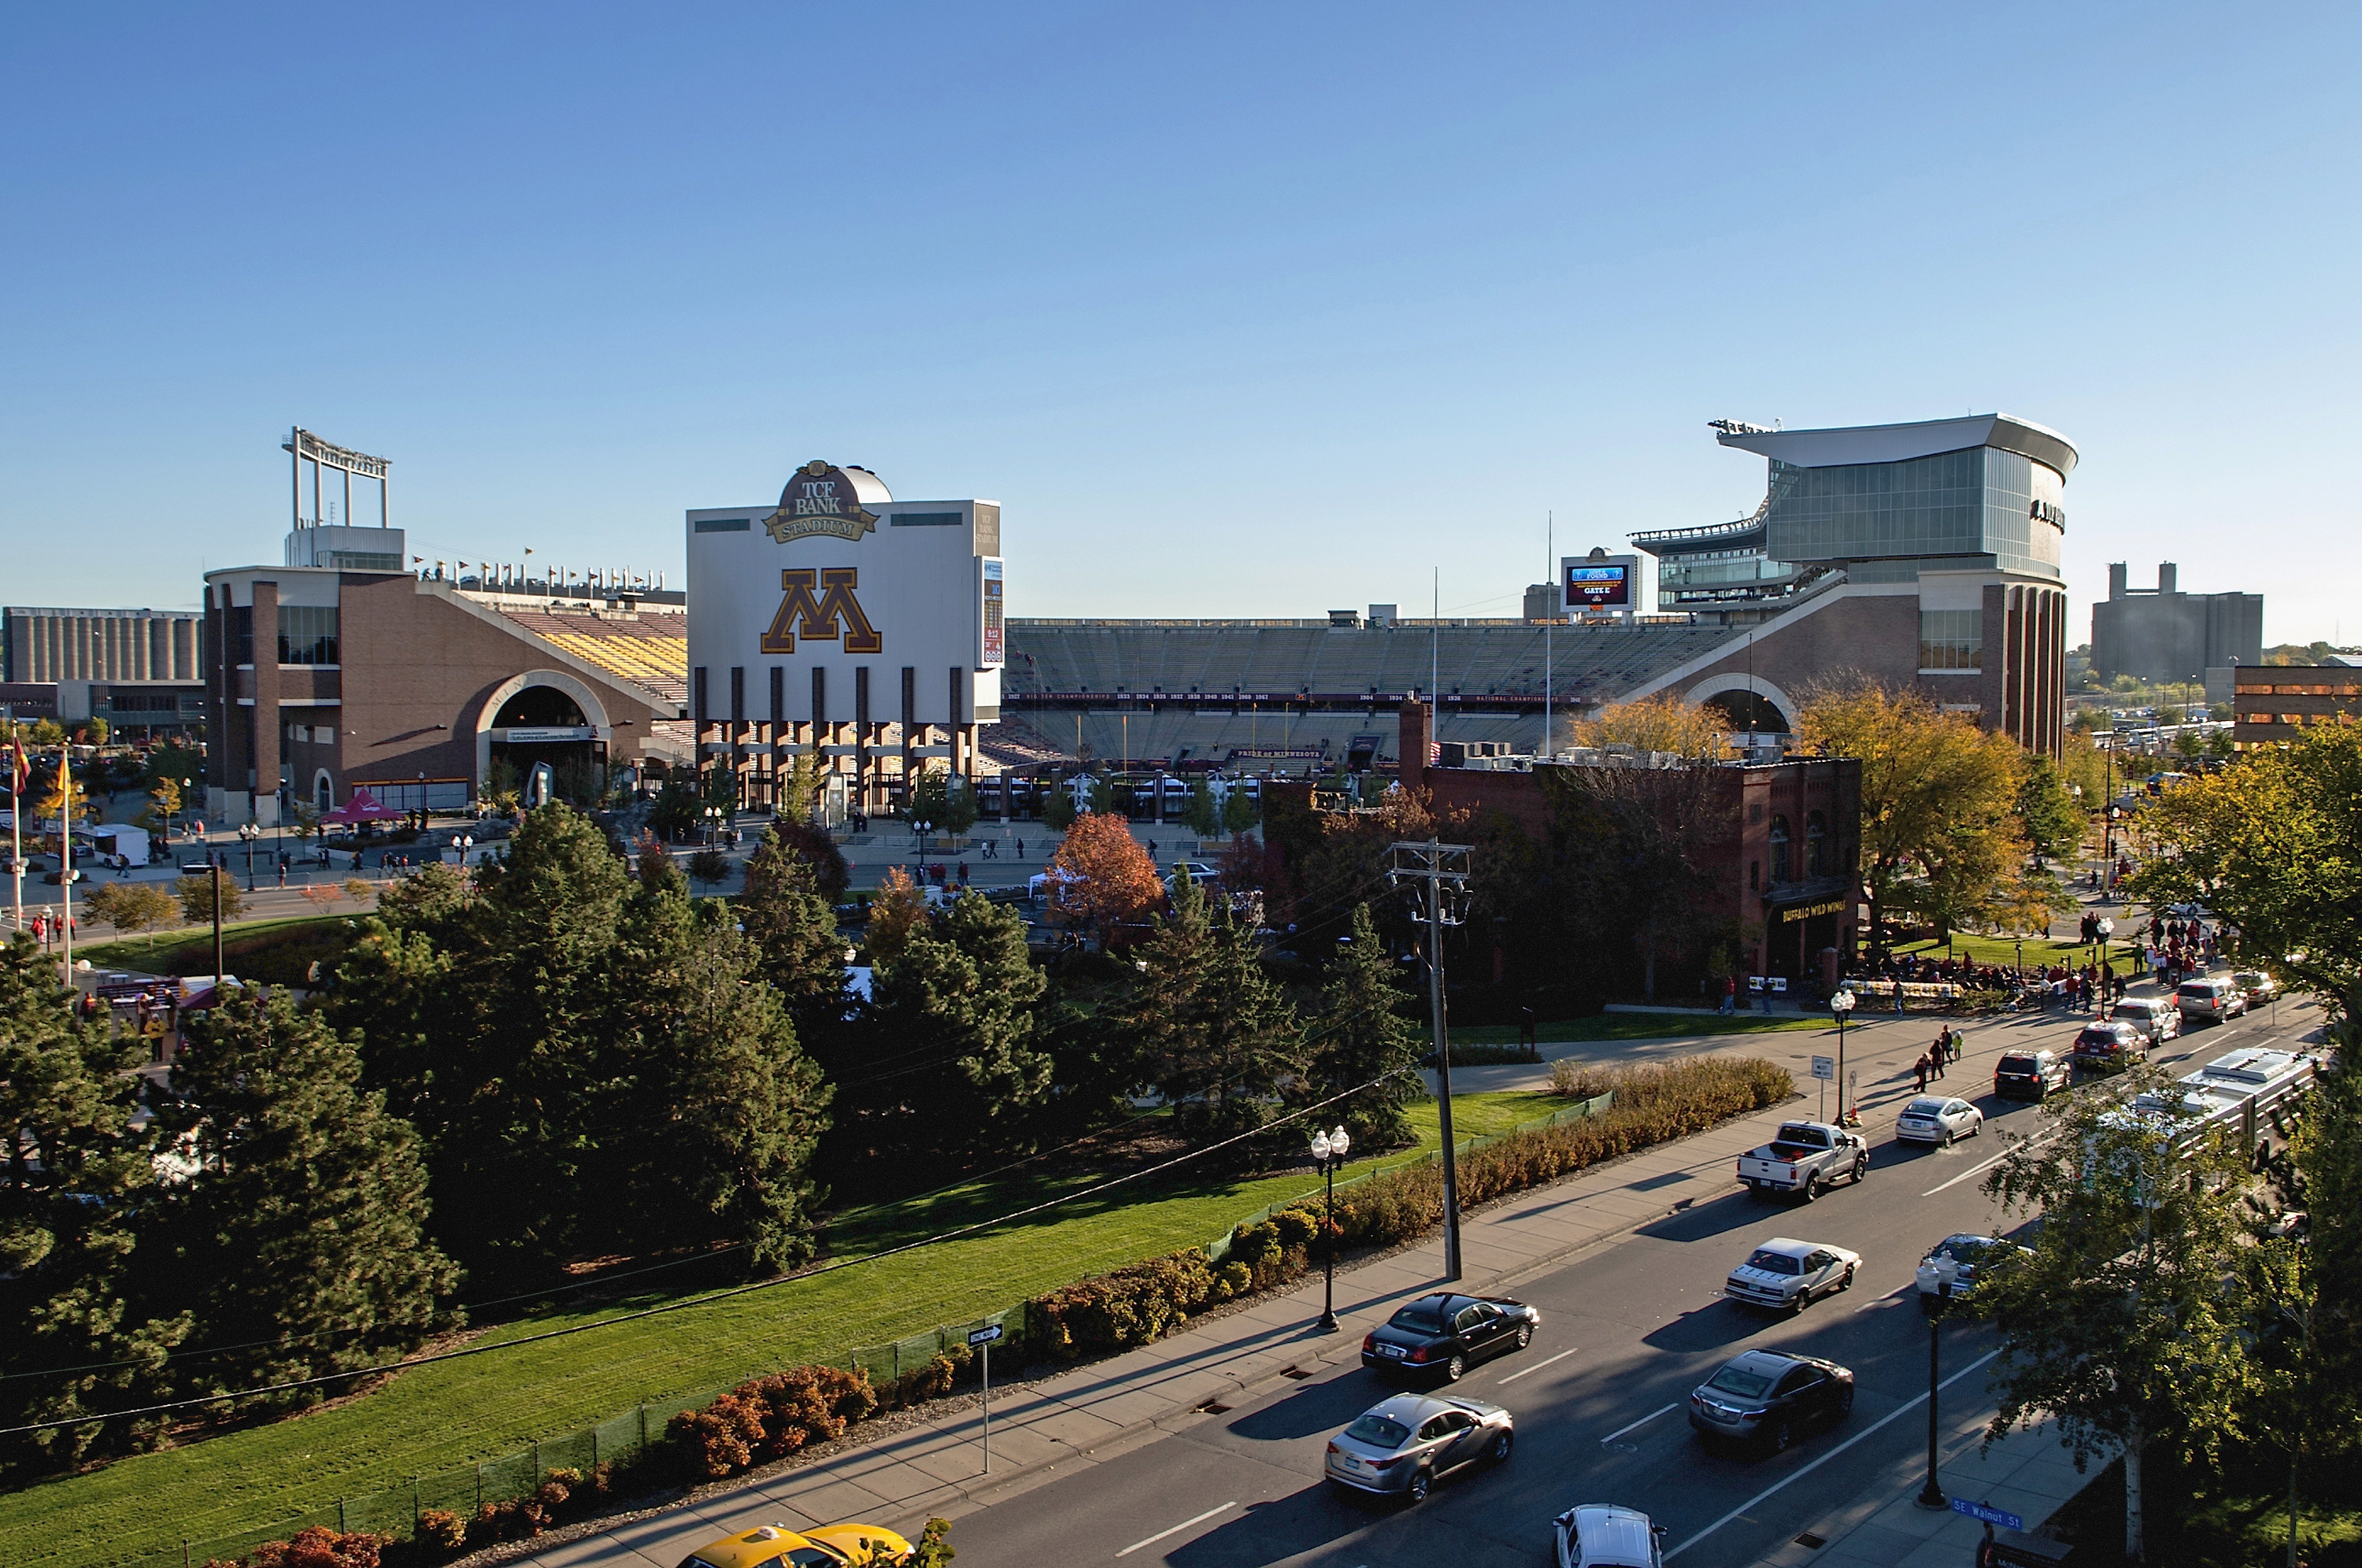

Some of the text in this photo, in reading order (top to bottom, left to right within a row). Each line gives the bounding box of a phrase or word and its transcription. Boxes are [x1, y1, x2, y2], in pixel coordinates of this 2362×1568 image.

[802, 481, 835, 499] TCF
[795, 497, 842, 516] BANK
[782, 519, 854, 538] STADIUM
[981, 514, 992, 524] TCF
[976, 534, 998, 544] STADIUM
[761, 567, 883, 654] M
[491, 673, 592, 710] MINNESOTA
[1783, 900, 1846, 923] BUFFALO WILD WINGS
[1954, 1500, 2020, 1527] SE Walnut St
